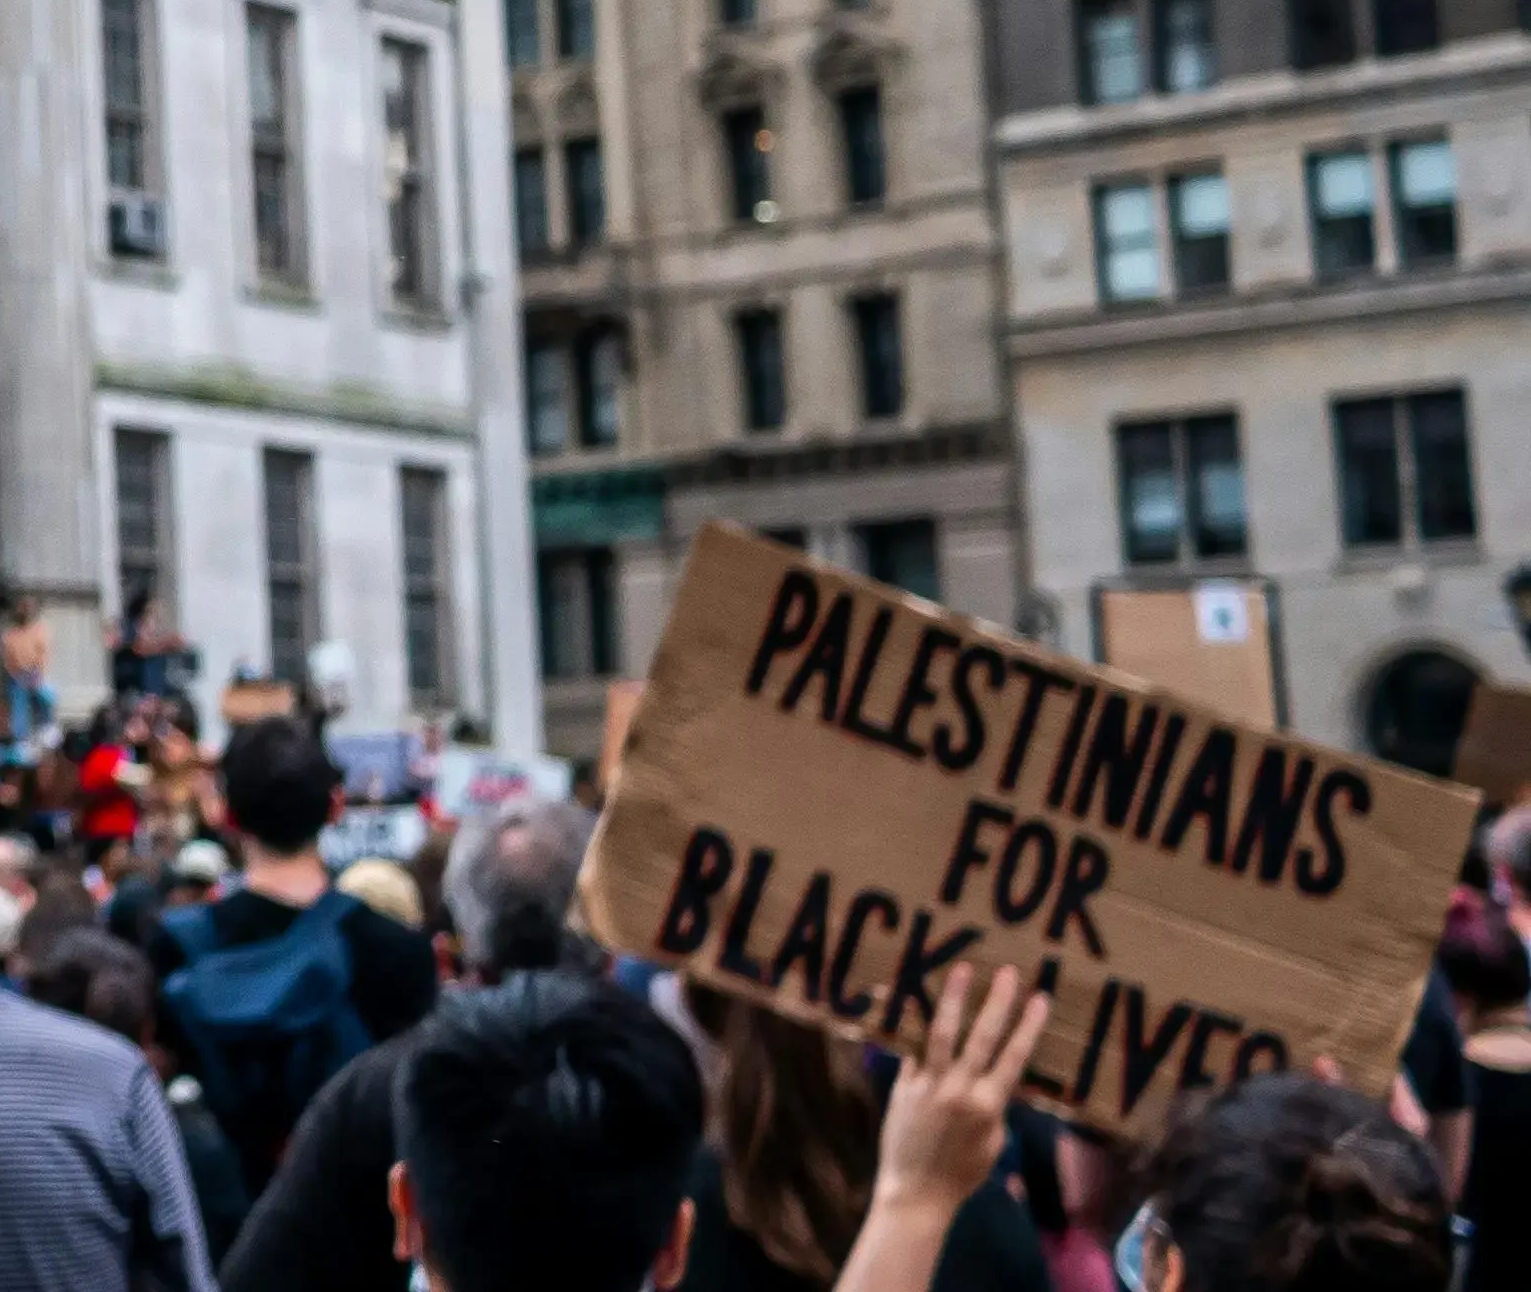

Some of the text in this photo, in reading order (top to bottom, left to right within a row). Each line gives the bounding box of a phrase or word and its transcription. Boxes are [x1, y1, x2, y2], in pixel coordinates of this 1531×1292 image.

[745, 567, 1372, 898] PALESTINIANS
[656, 825, 985, 1037] BLACK
[939, 798, 1110, 960] FOR
